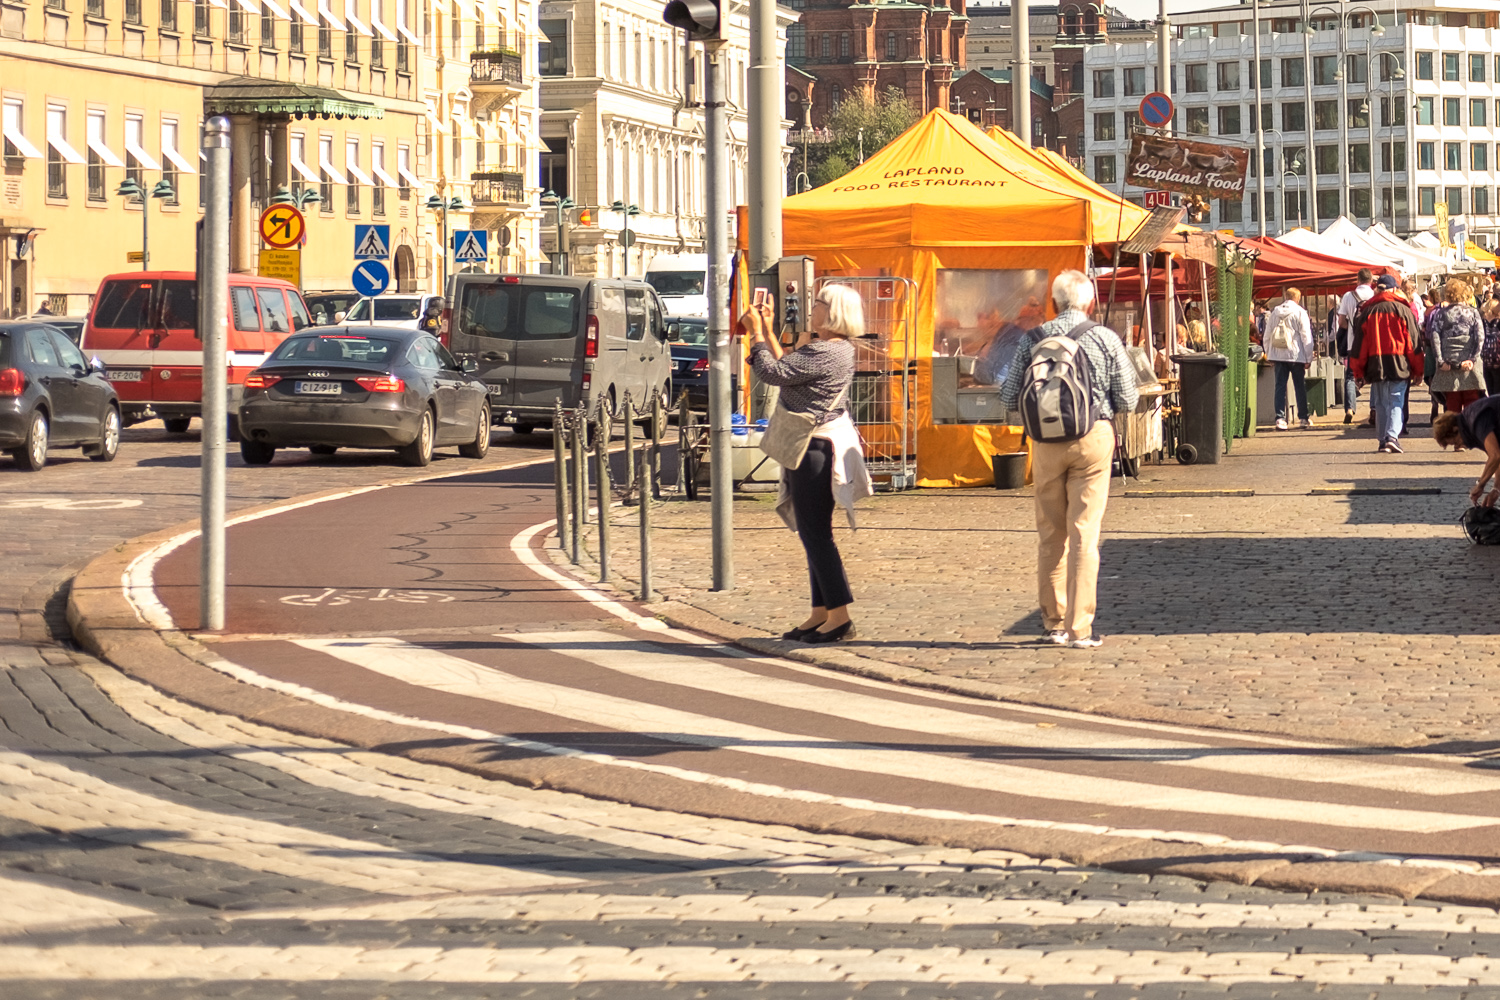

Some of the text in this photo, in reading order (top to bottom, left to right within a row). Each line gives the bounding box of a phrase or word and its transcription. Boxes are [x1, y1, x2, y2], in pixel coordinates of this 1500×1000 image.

[884, 166, 964, 179] LAPLAND
[1132, 162, 1243, 191] Lapland Food
[833, 179, 1008, 193] FOOD RESTAURANT
[1148, 193, 1167, 206] 4 7
